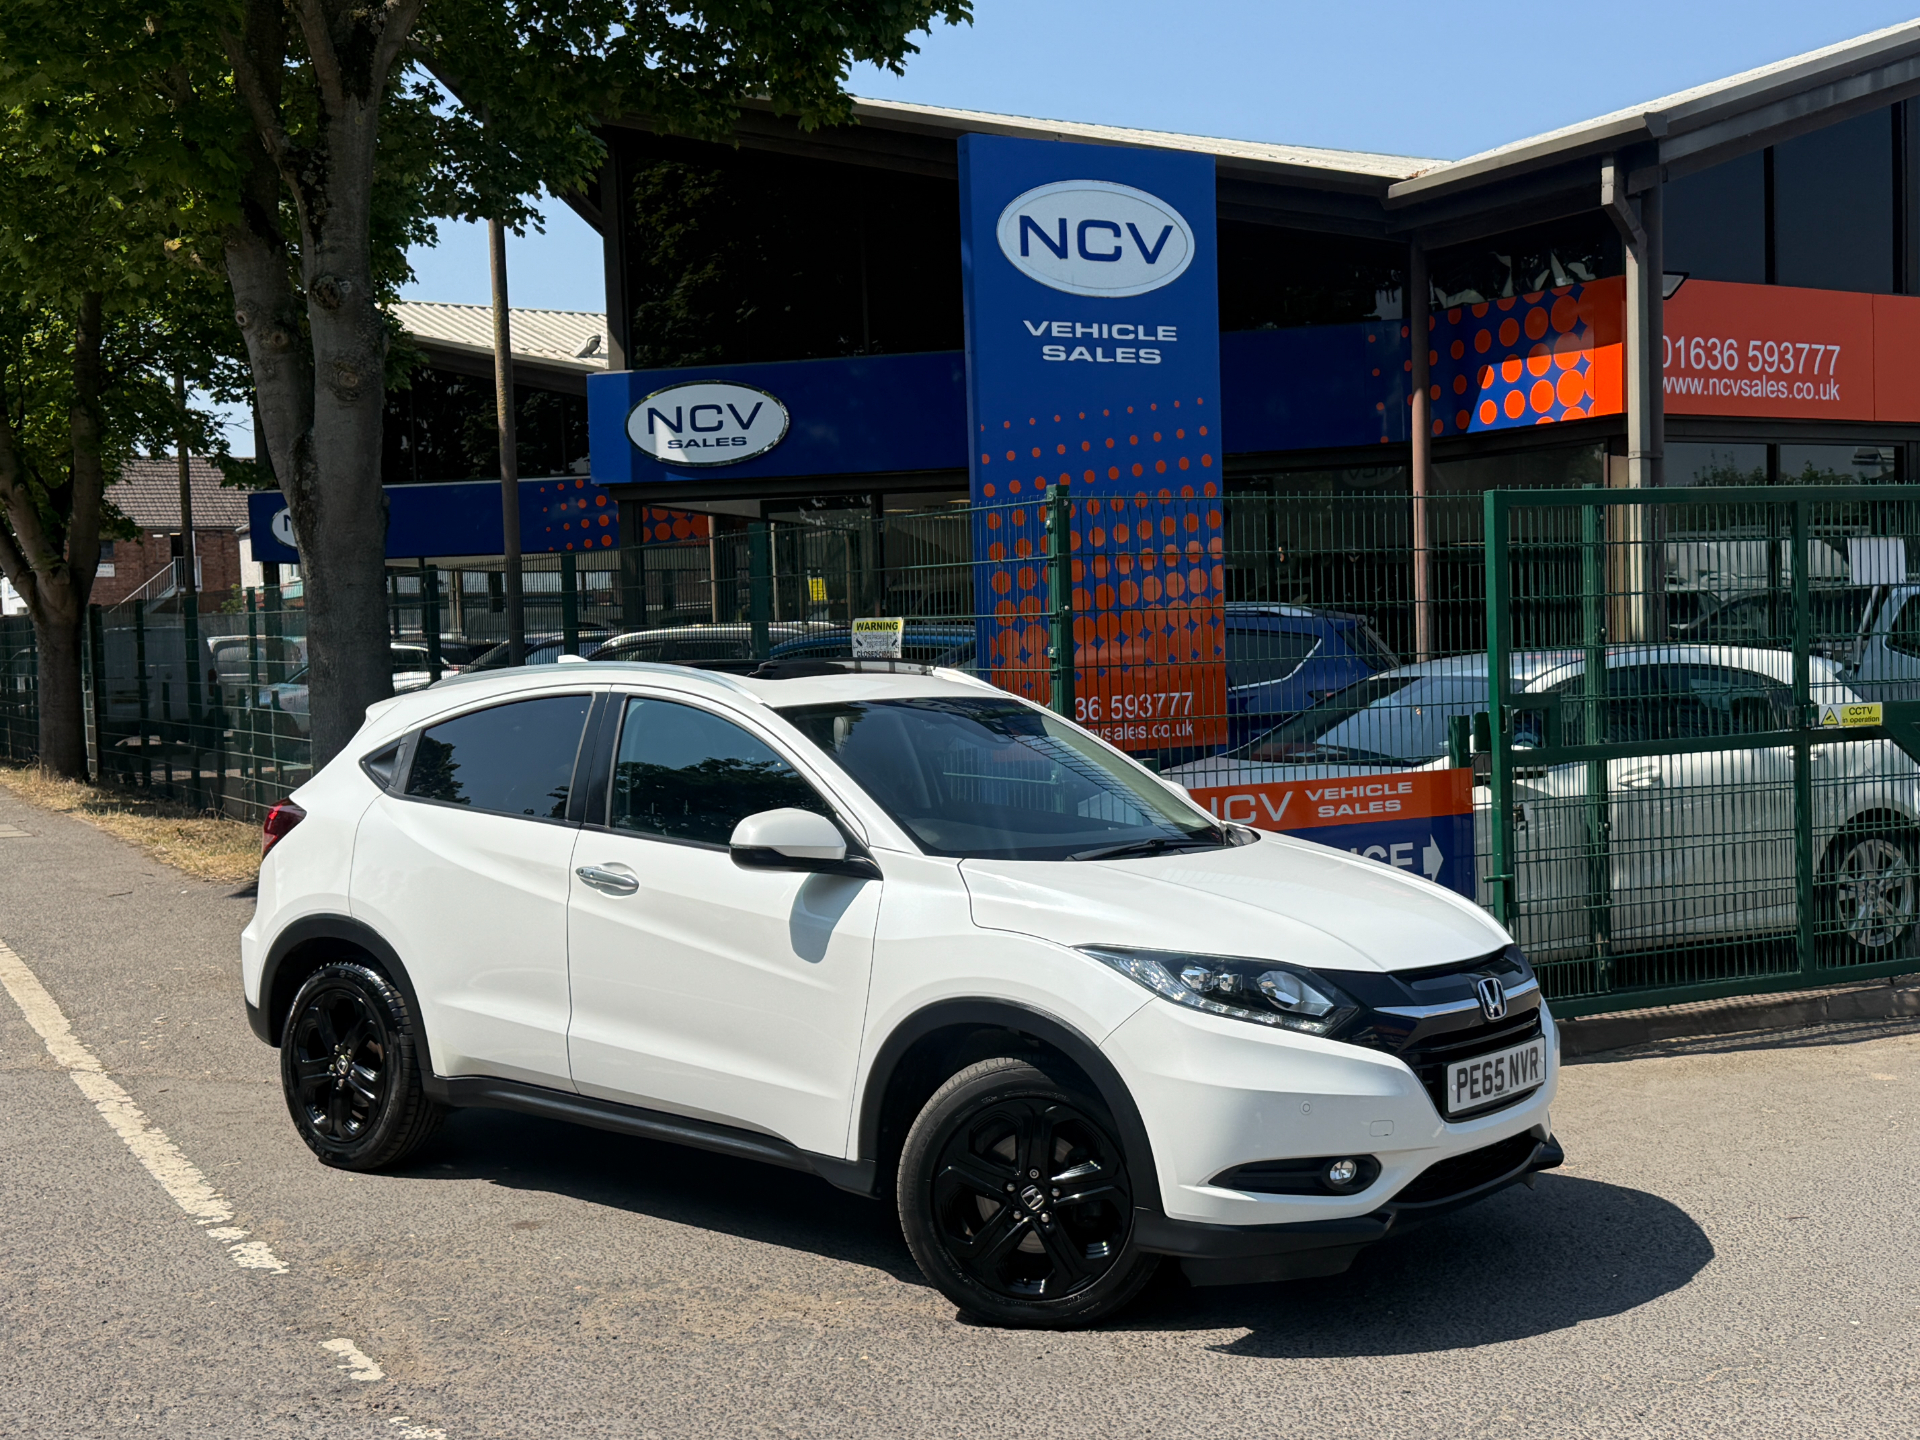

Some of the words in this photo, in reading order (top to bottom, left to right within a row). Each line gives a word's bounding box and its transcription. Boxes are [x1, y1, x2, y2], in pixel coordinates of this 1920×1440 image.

[1019, 215, 1174, 265] NCV
[1023, 320, 1178, 342] VEHICLE
[1042, 345, 1162, 365] SALES
[1663, 335, 1739, 371] 01636
[1747, 340, 1841, 376] 593777
[1663, 375, 1841, 401] www.ncvsales.co.uk
[647, 402, 764, 435] NCV
[667, 436, 747, 449] SALES
[856, 621, 898, 631] WARNING
[1111, 691, 1195, 719] 593777
[1849, 707, 1873, 715] CCTV
[1850, 716, 1879, 724] operation
[1305, 781, 1413, 801] VEHICLE
[1317, 800, 1402, 818] SALES
[1457, 1057, 1505, 1104] PE65
[1509, 1046, 1539, 1088] NVR
